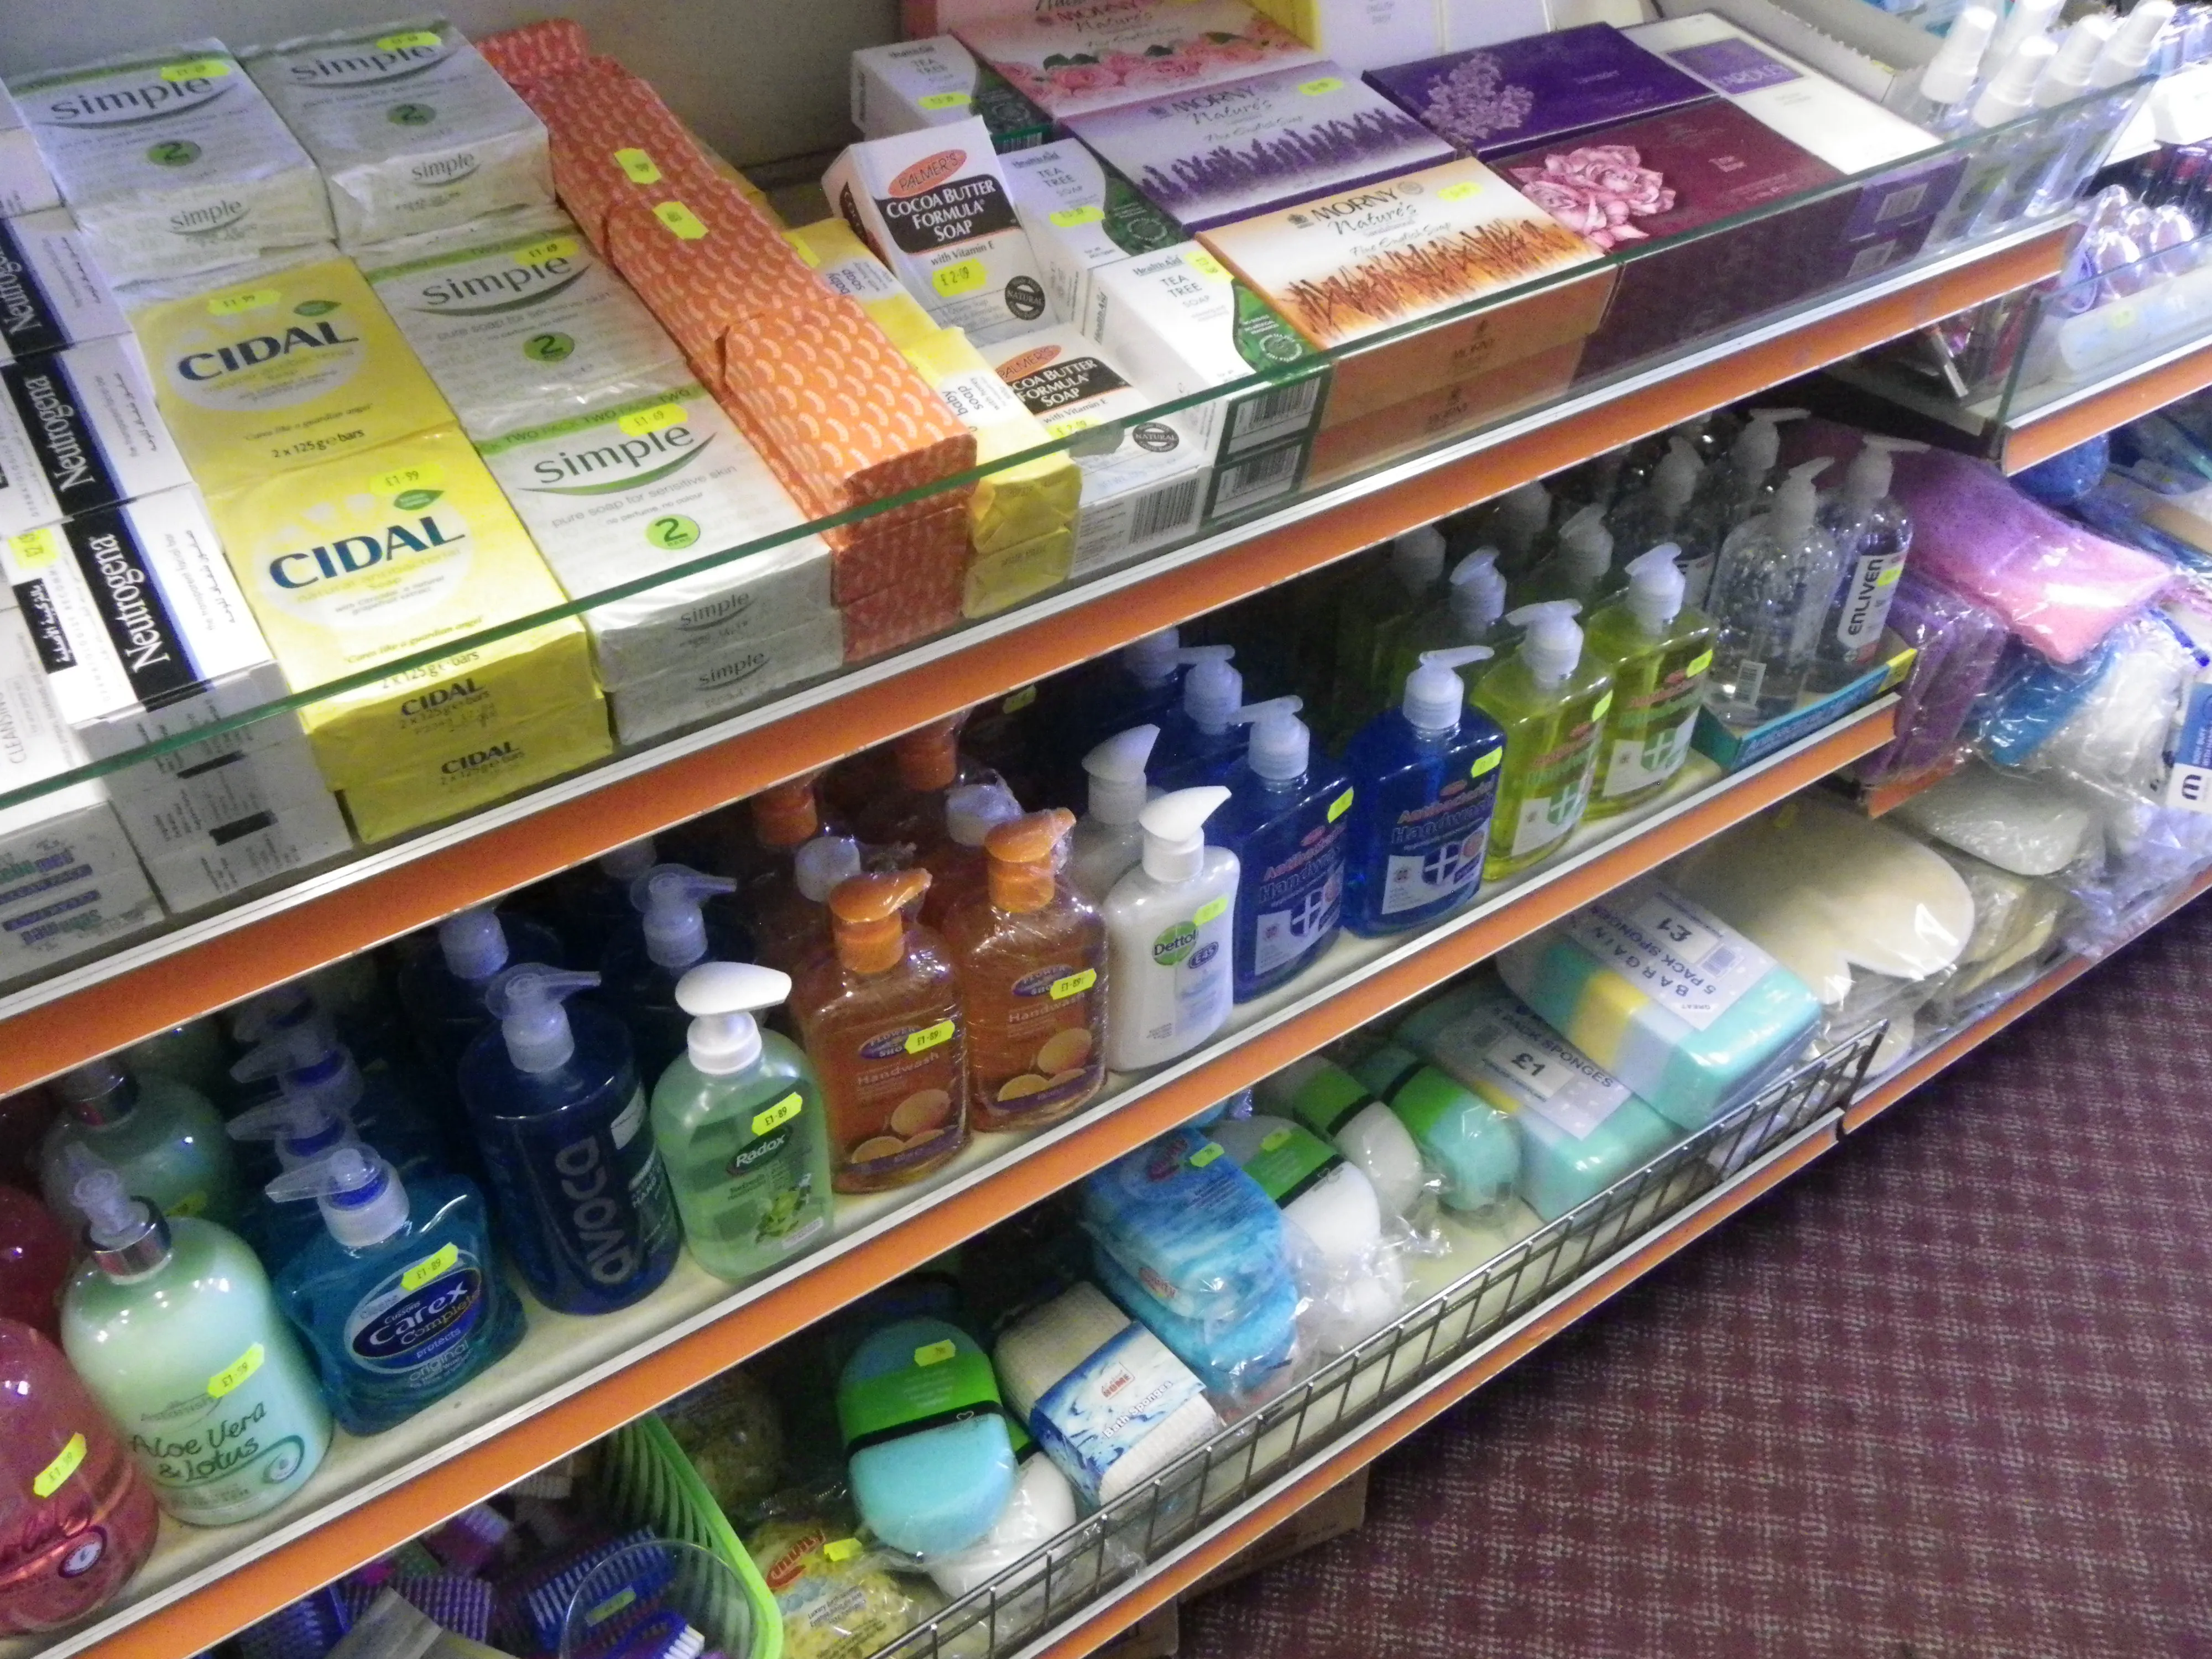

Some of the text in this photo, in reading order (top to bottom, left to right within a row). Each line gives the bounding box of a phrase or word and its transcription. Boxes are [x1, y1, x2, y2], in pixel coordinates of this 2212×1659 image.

[51, 79, 213, 120] simple
[1171, 86, 1255, 114] MORNY
[165, 141, 191, 161] 2
[412, 152, 474, 180] simple
[899, 151, 958, 191] PALMER'S
[1037, 169, 1064, 178] TEA
[1044, 175, 1076, 187] TREE
[887, 179, 996, 218] COCOA BUTTER
[1311, 187, 1398, 221] MORNY
[170, 200, 242, 227] simple
[1327, 202, 1416, 235] Nature's
[933, 220, 973, 242] SOAP
[931, 252, 951, 266] with
[952, 244, 988, 260] Vitamin
[0, 249, 42, 335] Neutrog
[422, 257, 572, 306] simple
[826, 273, 851, 295] baby
[842, 269, 865, 291] soap
[1160, 275, 1190, 286] TEA
[1167, 283, 1202, 298] TREE
[1007, 289, 1043, 307] NATURAL
[1182, 295, 1210, 308] SOAP
[178, 322, 359, 381] CIDAL
[533, 335, 565, 358] 2
[997, 345, 1055, 379] PALMER'S
[1046, 357, 1097, 378] BUTTER
[942, 390, 969, 416] baby
[958, 385, 984, 410] soap
[1041, 387, 1080, 408] SOAP
[506, 429, 539, 445] TWO
[583, 409, 616, 424] TWO
[1044, 411, 1065, 425] with
[1066, 401, 1099, 418] Vitamin
[23, 374, 96, 494] Neutrogena
[271, 448, 280, 458] 2
[337, 429, 365, 442] bars
[1134, 431, 1177, 441] NATURAL
[533, 426, 695, 483] simple
[551, 463, 738, 530] pure soap for sensitive skin
[655, 517, 688, 543] 2
[269, 516, 466, 589] CIDAL
[88, 533, 171, 674] Neutrogena
[680, 591, 750, 627] simple
[698, 650, 765, 684] simple
[401, 677, 487, 716] CIDAL
[442, 741, 520, 774] CIDAL
[1154, 928, 1198, 956] Dettol
[1656, 917, 1692, 943] £1
[1663, 956, 1705, 986] PACK
[1703, 984, 1717, 995] 5
[879, 1044, 904, 1057] SHO
[1510, 1052, 1546, 1077] £1
[1548, 1039, 1614, 1088] SPONGES
[736, 1134, 785, 1168] Radox
[370, 1281, 468, 1345] Carex
[385, 1301, 421, 1324] Cussons
[417, 1327, 461, 1359] protects
[409, 1339, 470, 1381] original
[1102, 1380, 1173, 1439] Bath Sponges
[131, 1401, 267, 1459] Aloe Vera
[184, 1437, 260, 1483] Lotus
